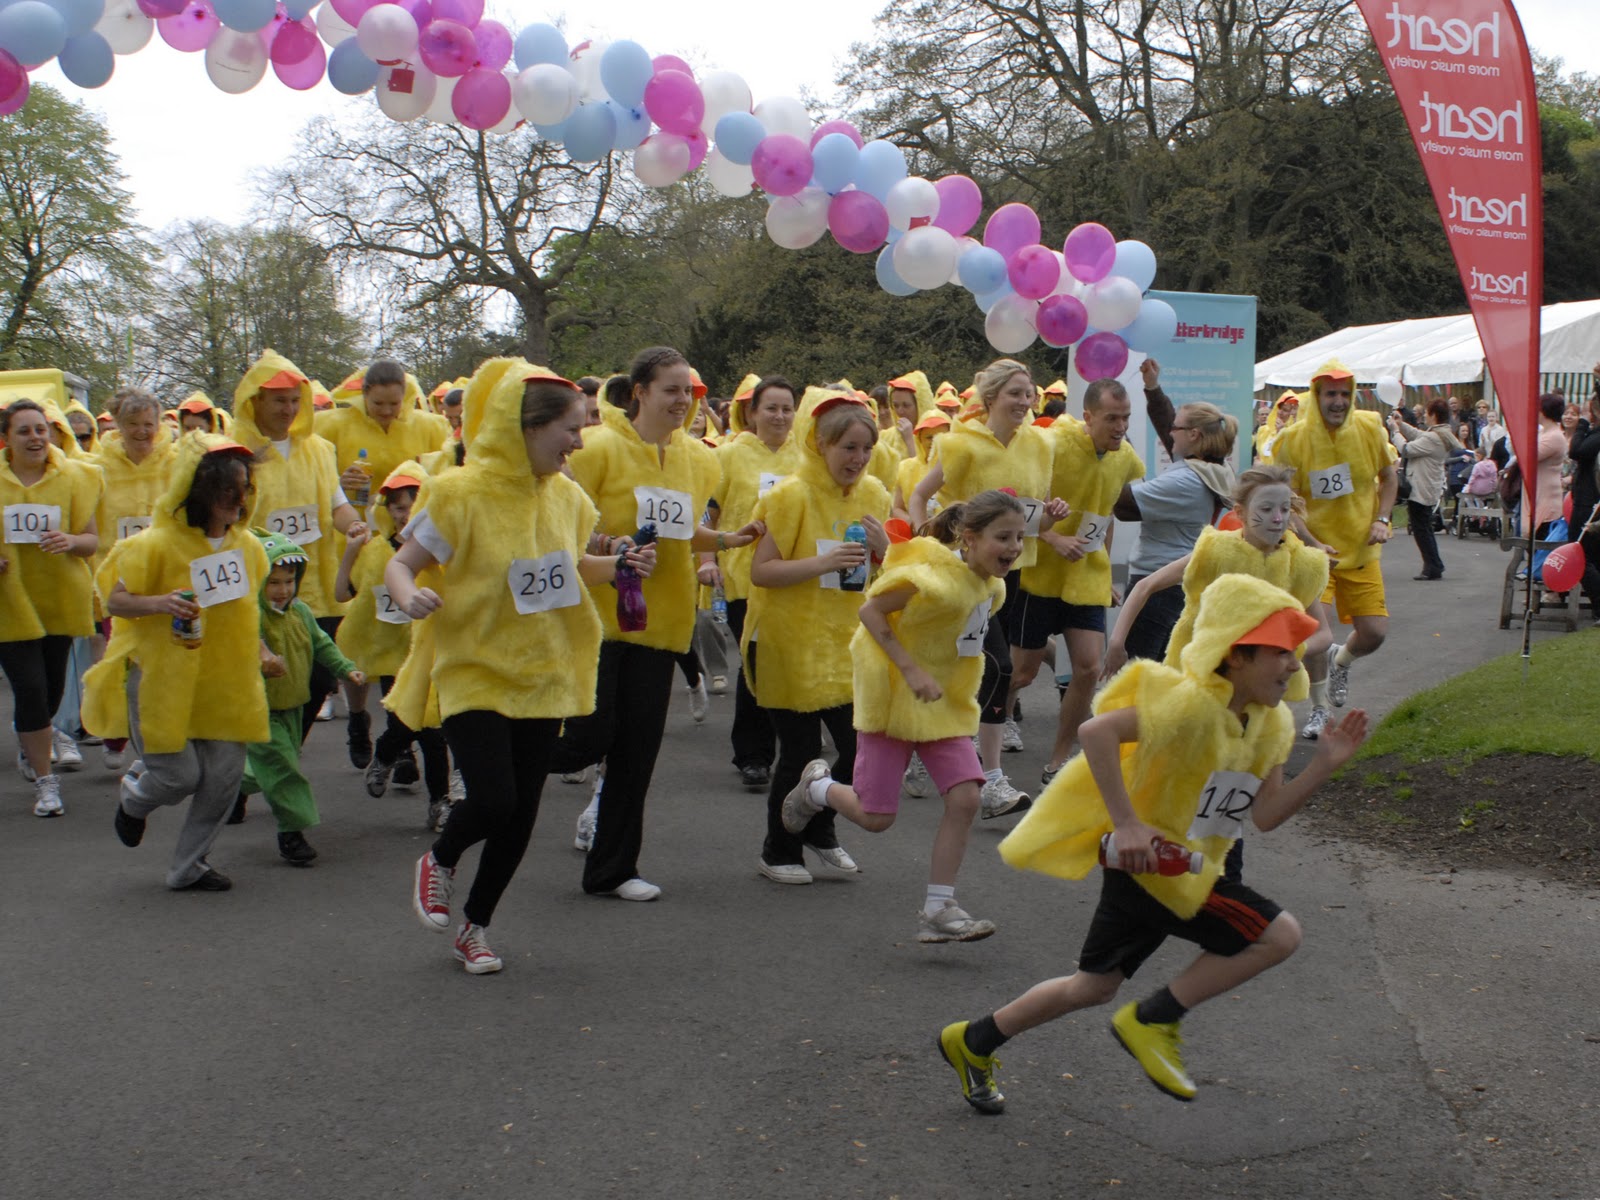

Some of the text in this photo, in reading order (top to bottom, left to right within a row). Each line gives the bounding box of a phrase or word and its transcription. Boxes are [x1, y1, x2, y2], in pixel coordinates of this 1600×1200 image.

[1318, 473, 1344, 494] 28
[11, 512, 51, 532] 101
[273, 512, 312, 536] 231
[645, 497, 685, 525] 162
[199, 561, 242, 592] 143
[1197, 786, 1254, 822] 142
